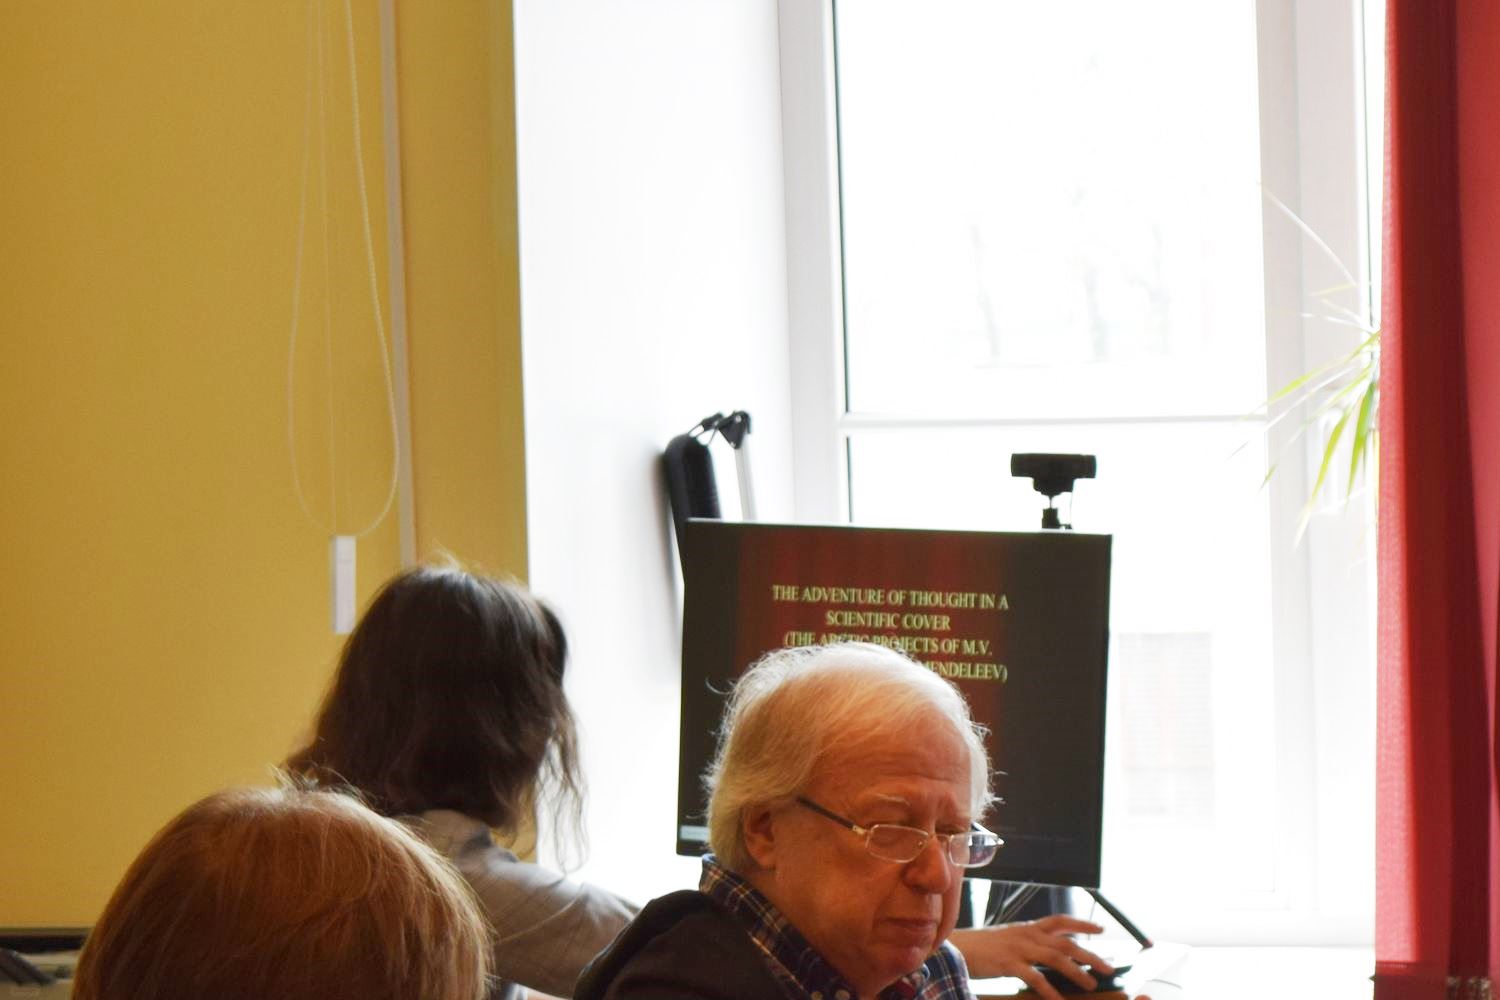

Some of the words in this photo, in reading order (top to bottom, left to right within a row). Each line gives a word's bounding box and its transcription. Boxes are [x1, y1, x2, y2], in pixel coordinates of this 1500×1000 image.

[773, 584, 800, 601] THE
[803, 586, 886, 605] ADVENTURE
[888, 589, 908, 606] OF
[909, 590, 979, 609] THOUGHT
[980, 592, 996, 609] IN
[998, 593, 1010, 611] A
[826, 609, 900, 629] SCIENTIFIC
[902, 612, 952, 631] COVER
[941, 637, 960, 655] OF
[963, 639, 993, 657] M.V.
